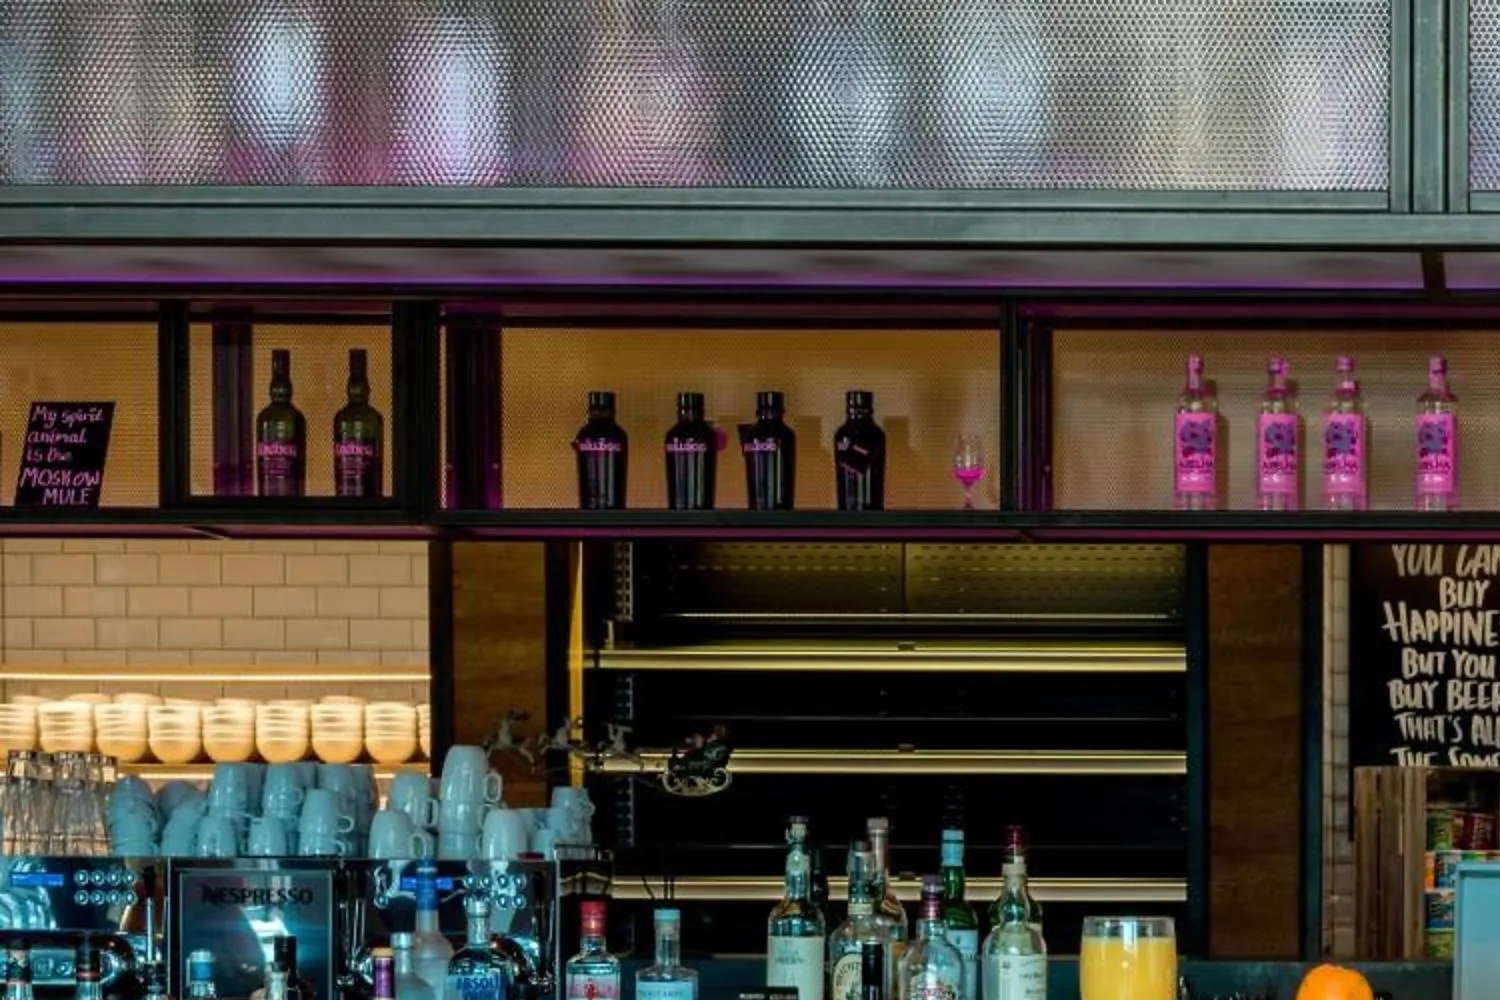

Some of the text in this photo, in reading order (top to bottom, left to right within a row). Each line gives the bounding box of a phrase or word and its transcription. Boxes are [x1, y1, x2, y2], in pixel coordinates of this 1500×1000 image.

[32, 405, 104, 429] My spirit
[27, 428, 87, 444] animal
[41, 487, 93, 505] MULE
[1392, 544, 1444, 577] YOU
[1387, 679, 1439, 710] BUY
[1394, 711, 1463, 744] THAT'S
[203, 883, 314, 906] NESPRESSO
